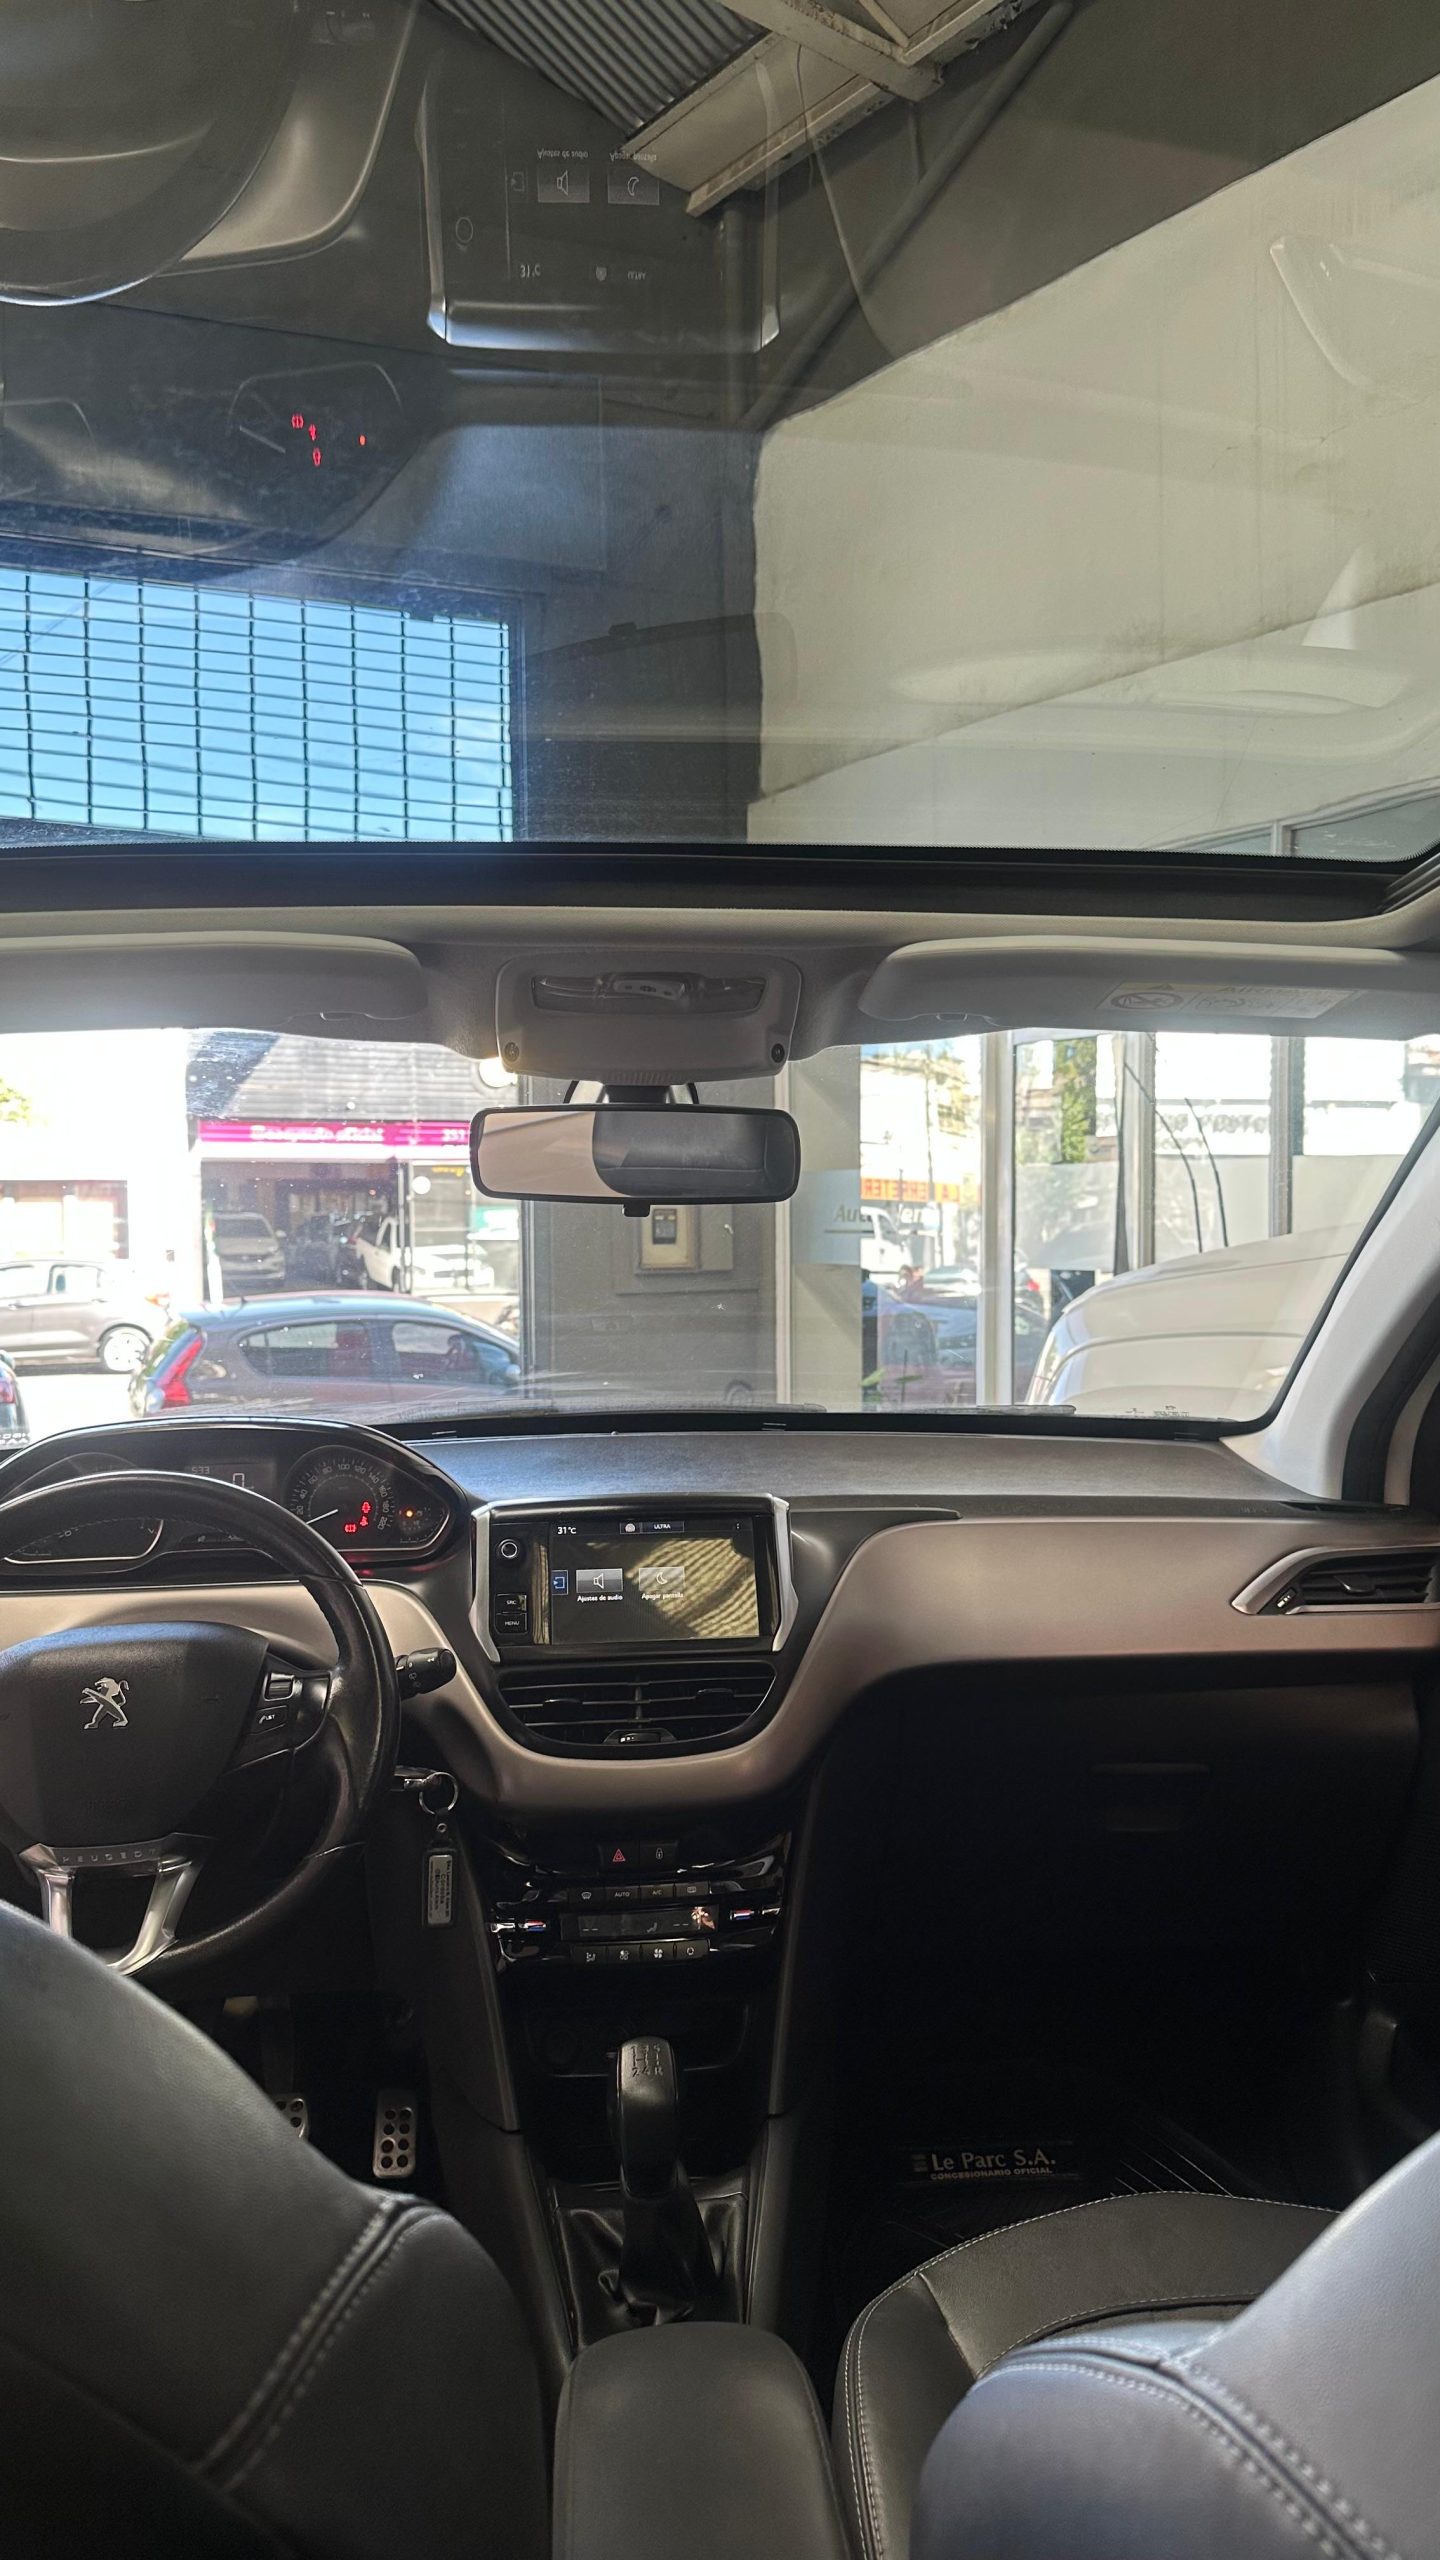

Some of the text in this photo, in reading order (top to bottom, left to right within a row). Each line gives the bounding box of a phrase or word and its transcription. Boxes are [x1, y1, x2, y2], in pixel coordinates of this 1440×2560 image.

[577, 1594, 598, 1602] Ajustes
[931, 2148, 1056, 2171] Le Parc S.A.
[930, 2166, 1053, 2180] CONCESIONARIO OFICIAL
